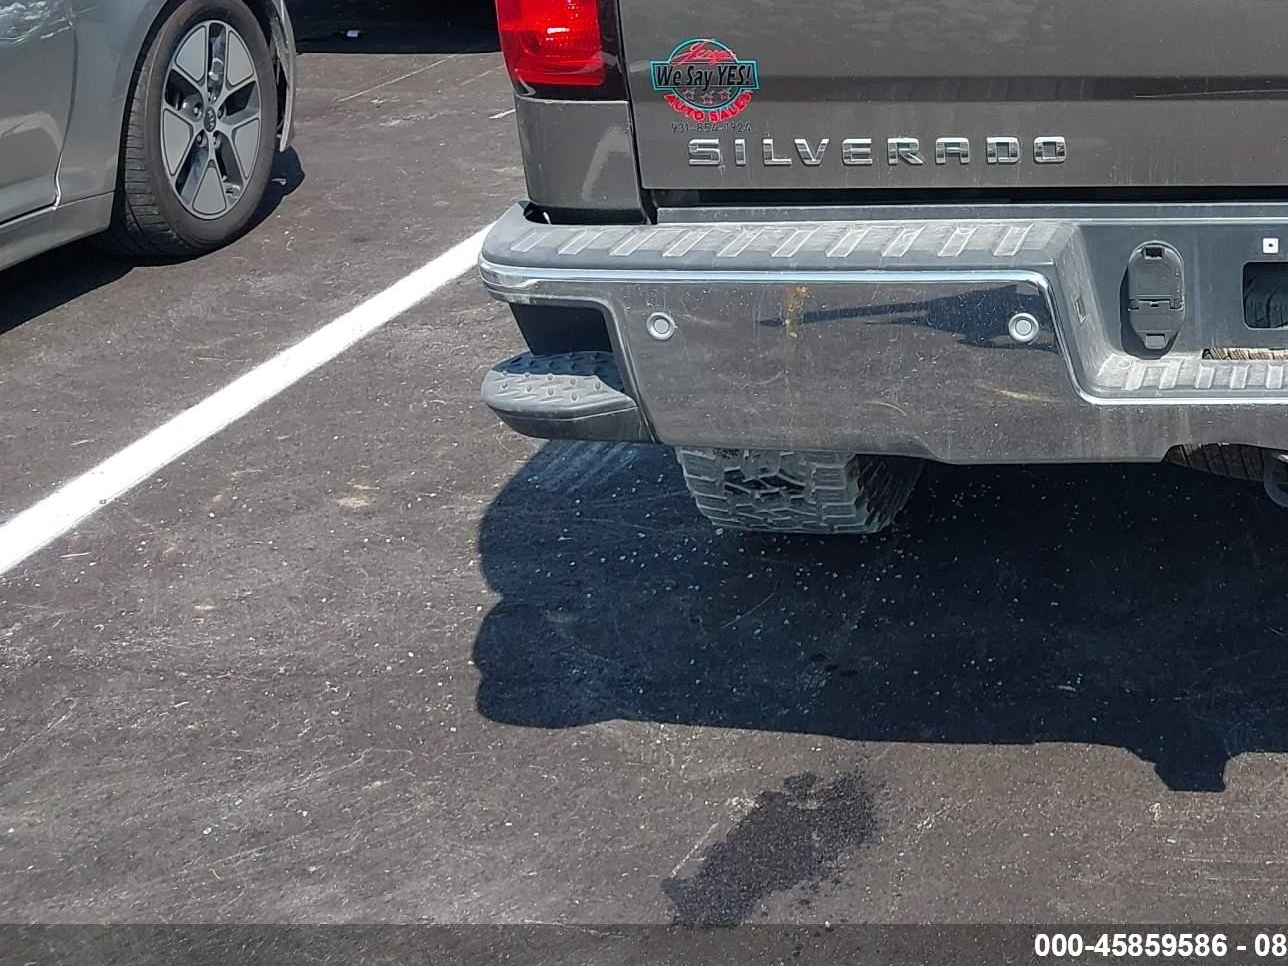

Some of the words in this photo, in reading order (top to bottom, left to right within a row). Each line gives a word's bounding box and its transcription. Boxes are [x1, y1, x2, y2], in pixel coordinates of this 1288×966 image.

[656, 65, 681, 86] We
[686, 65, 713, 92] Say
[718, 65, 752, 86] YES!
[664, 94, 706, 122] AUTO
[709, 90, 754, 124] SALES
[671, 121, 752, 135] 931-854-1924
[687, 136, 1067, 166] SILVERADO
